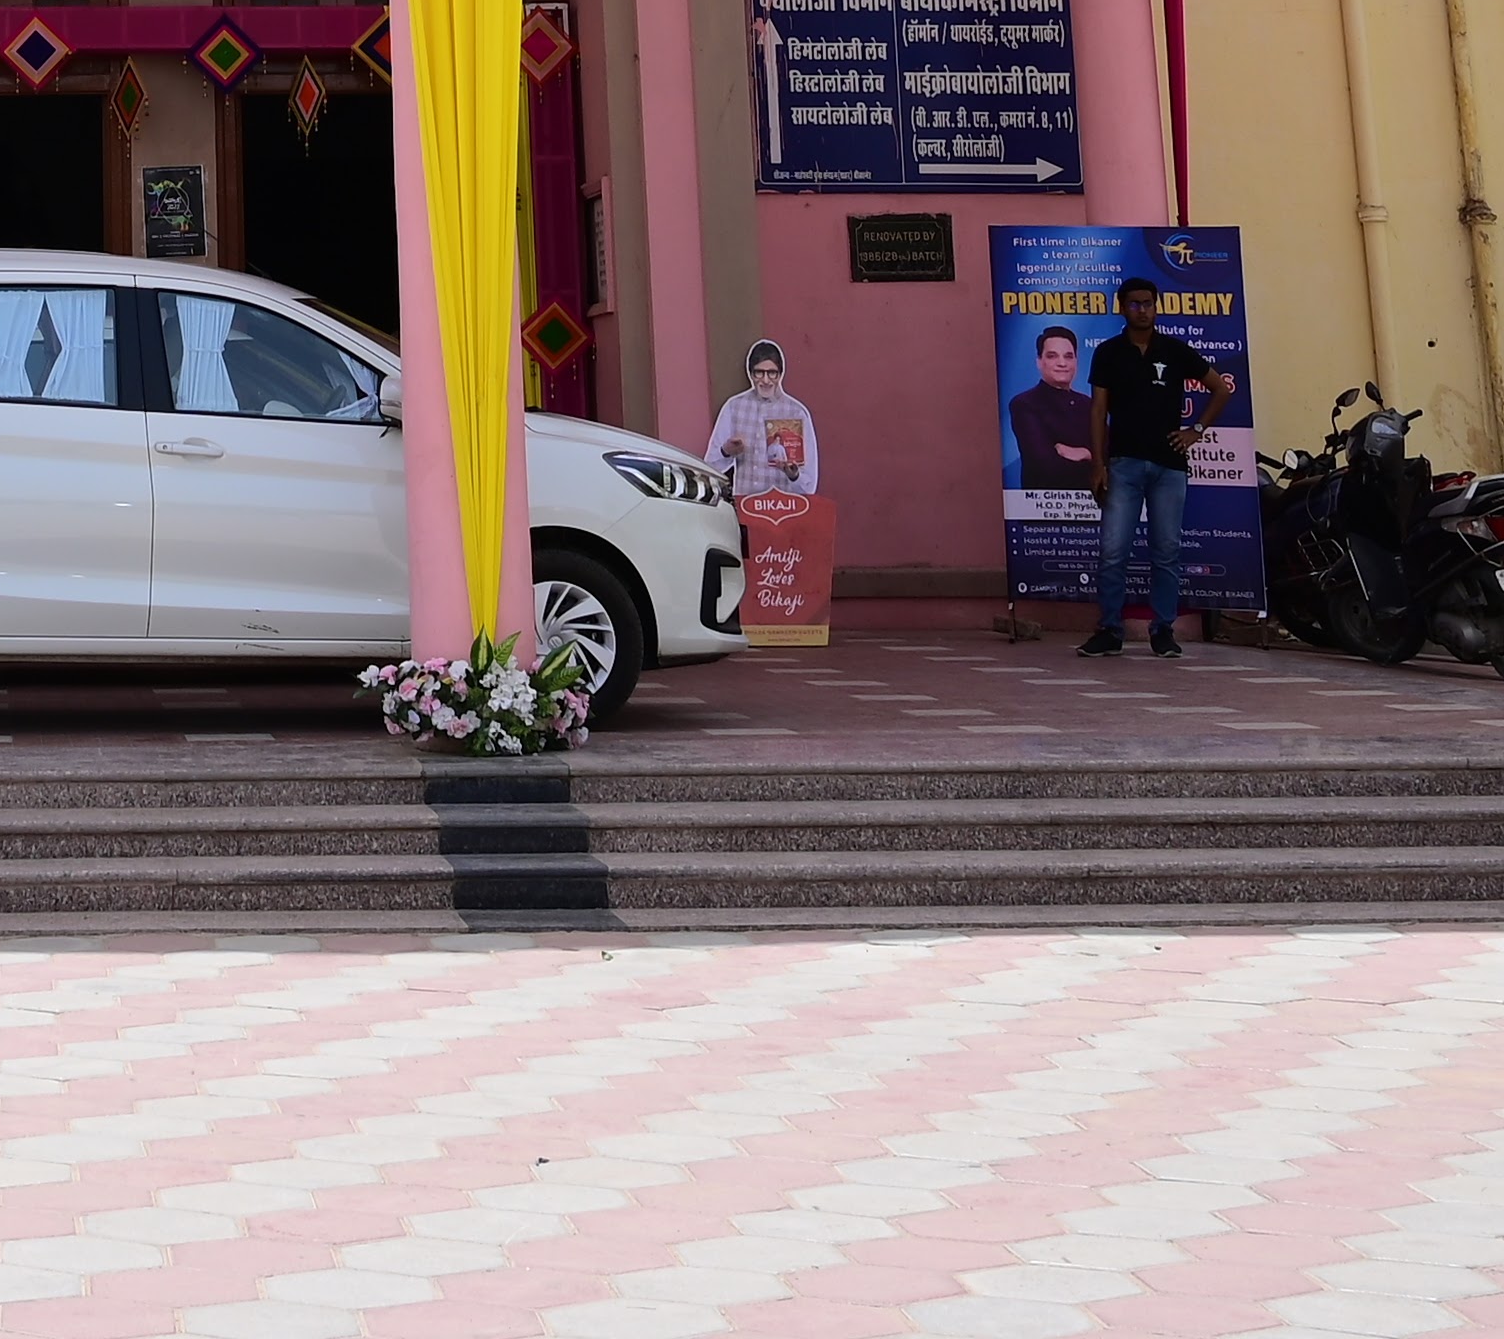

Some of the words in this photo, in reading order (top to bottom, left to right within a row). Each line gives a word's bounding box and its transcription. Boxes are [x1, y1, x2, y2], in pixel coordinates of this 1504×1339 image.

[787, 37, 864, 61] हिमेटोलोजी
[865, 38, 887, 61] लेब
[789, 70, 860, 93] हिस्टोलोजी
[862, 70, 885, 93] लेब
[1025, 67, 1070, 95] विभाग
[791, 102, 869, 126] सायटोलोजी
[871, 103, 894, 126] लेब
[863, 231, 921, 242] RENOVATED
[923, 231, 935, 241] BY
[1013, 237, 1038, 247] First
[1040, 237, 1065, 247] time
[1081, 237, 1122, 247] Bikaner
[912, 251, 943, 261] BATCH
[1052, 250, 1080, 259] team
[1016, 262, 1072, 274] legendary
[1074, 262, 1122, 273] faculties
[1017, 275, 1059, 287] coming
[1061, 275, 1110, 287] together
[1002, 291, 1107, 314] PIONEER
[1187, 325, 1204, 337] for
[1186, 466, 1244, 481] Bikaner
[1025, 491, 1041, 501] Mr.
[1043, 491, 1073, 501] Girish
[754, 498, 796, 511] BIKAJI
[757, 567, 795, 588] Loves
[757, 588, 804, 616] Bikaji
